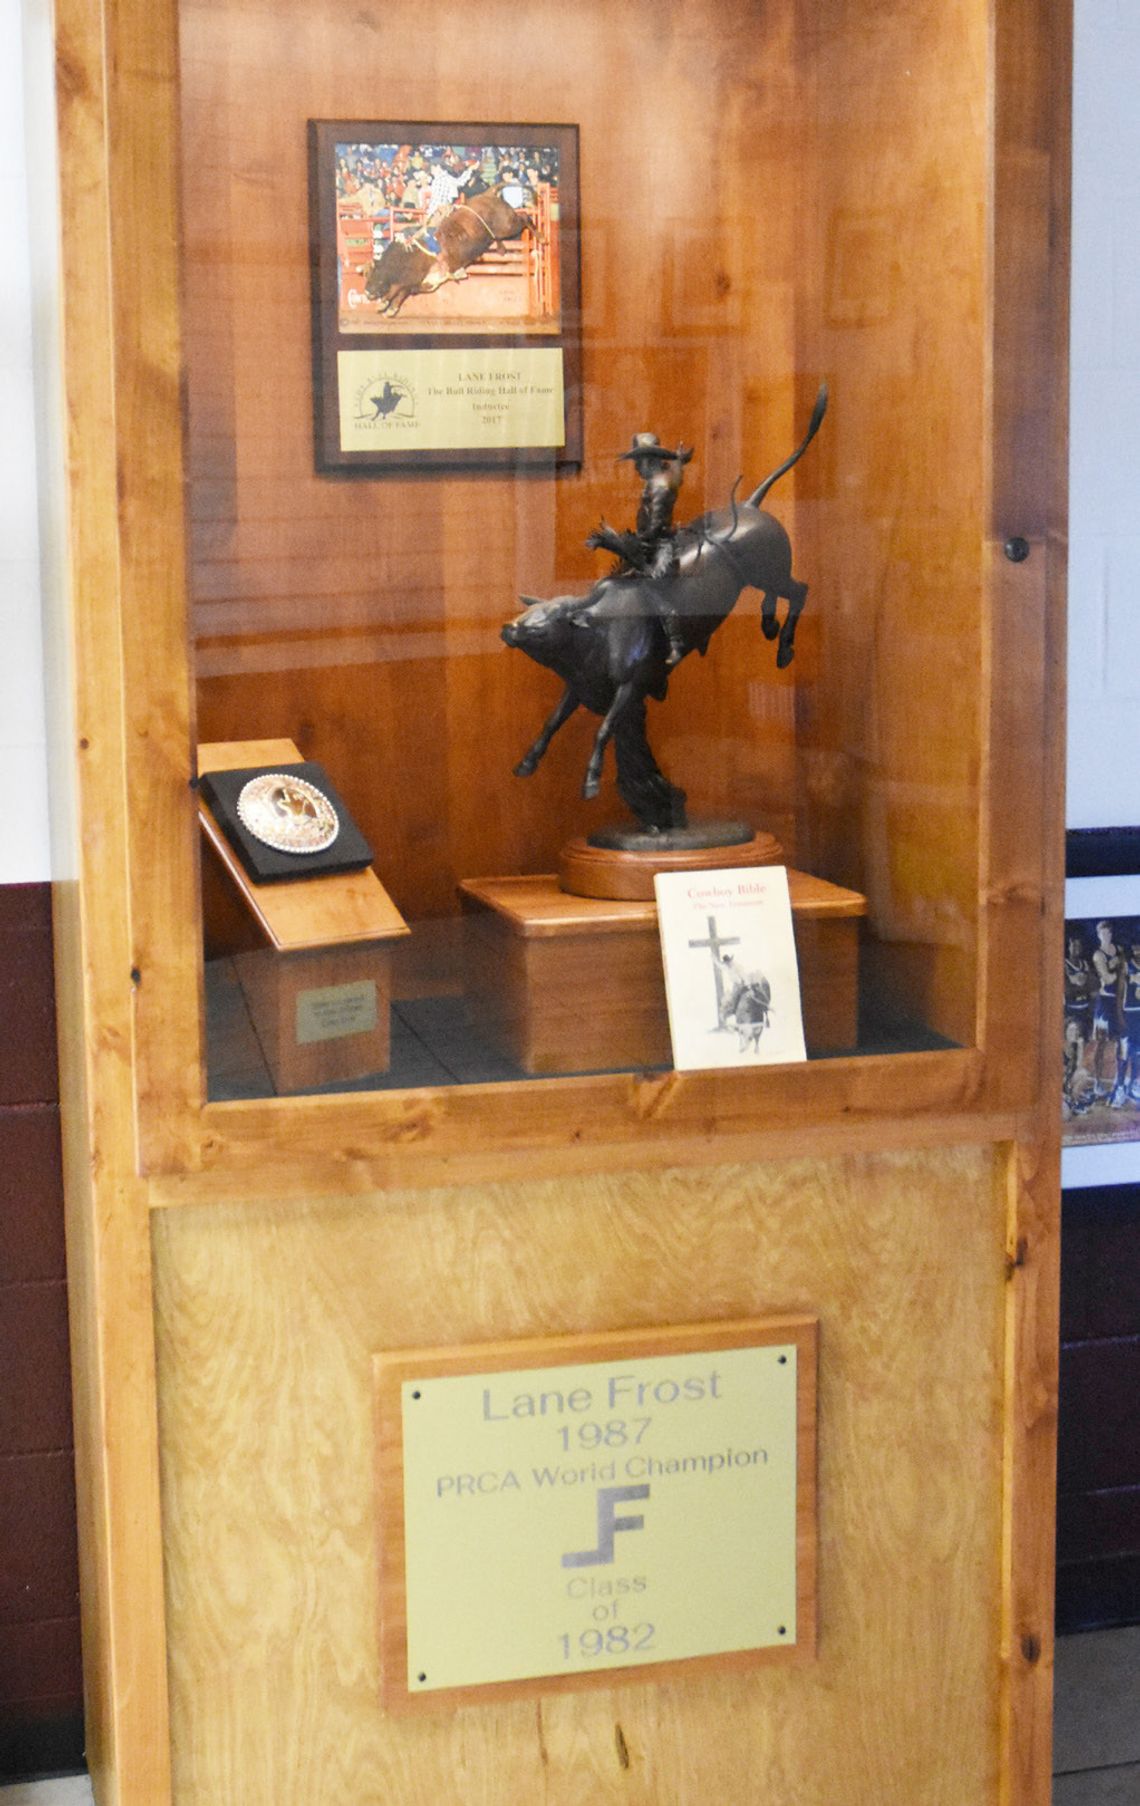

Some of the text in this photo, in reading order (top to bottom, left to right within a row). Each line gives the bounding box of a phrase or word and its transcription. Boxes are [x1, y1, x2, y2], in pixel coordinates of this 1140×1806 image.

[488, 371, 521, 381] FROST
[466, 385, 496, 397] Riding
[481, 415, 502, 425] 2017
[687, 883, 768, 899] Cowboy Bible
[482, 1370, 723, 1421] Lane Frost
[557, 1417, 652, 1452] 1987
[436, 1445, 769, 1498] PRCA World Champion
[566, 1573, 648, 1599] Class
[591, 1600, 620, 1622] of
[558, 1622, 656, 1660] 1982
